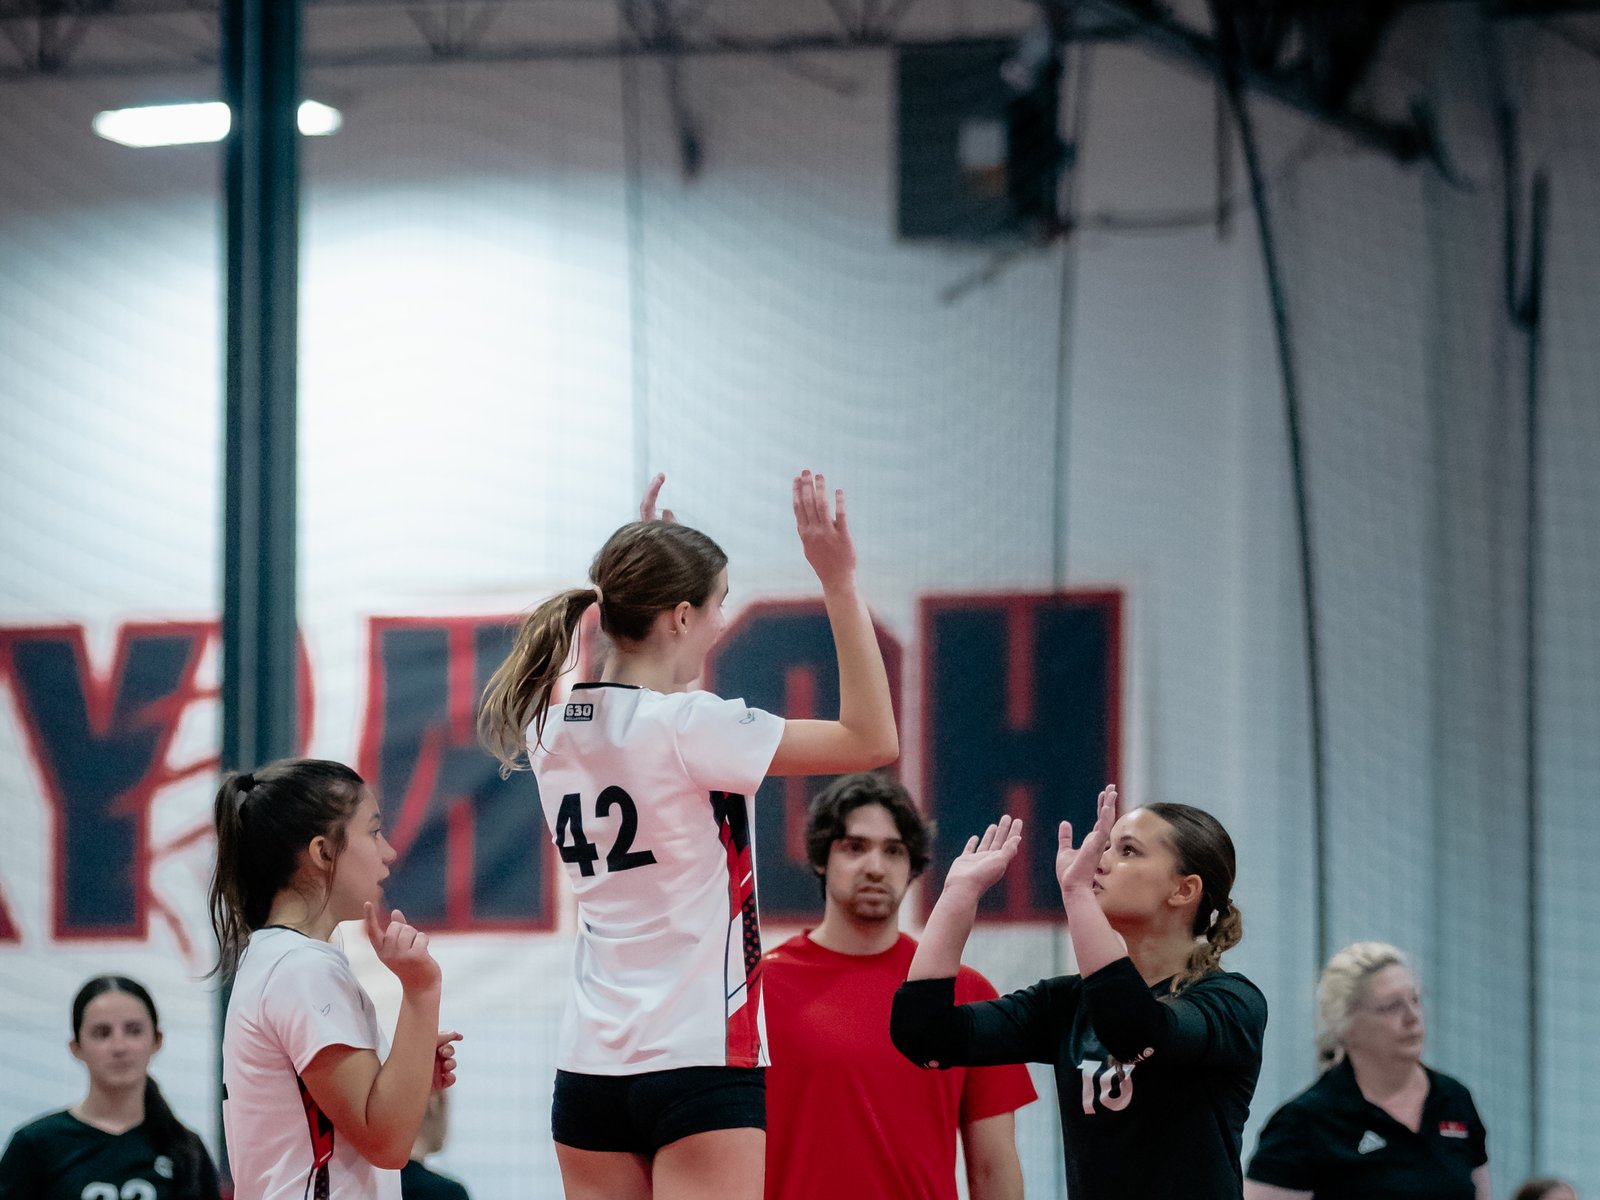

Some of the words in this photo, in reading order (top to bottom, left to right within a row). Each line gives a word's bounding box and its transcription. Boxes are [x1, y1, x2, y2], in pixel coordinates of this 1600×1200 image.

[566, 704, 592, 717] 630
[0, 619, 212, 943] Y
[555, 785, 657, 877] 42
[1077, 1059, 1136, 1115] 10
